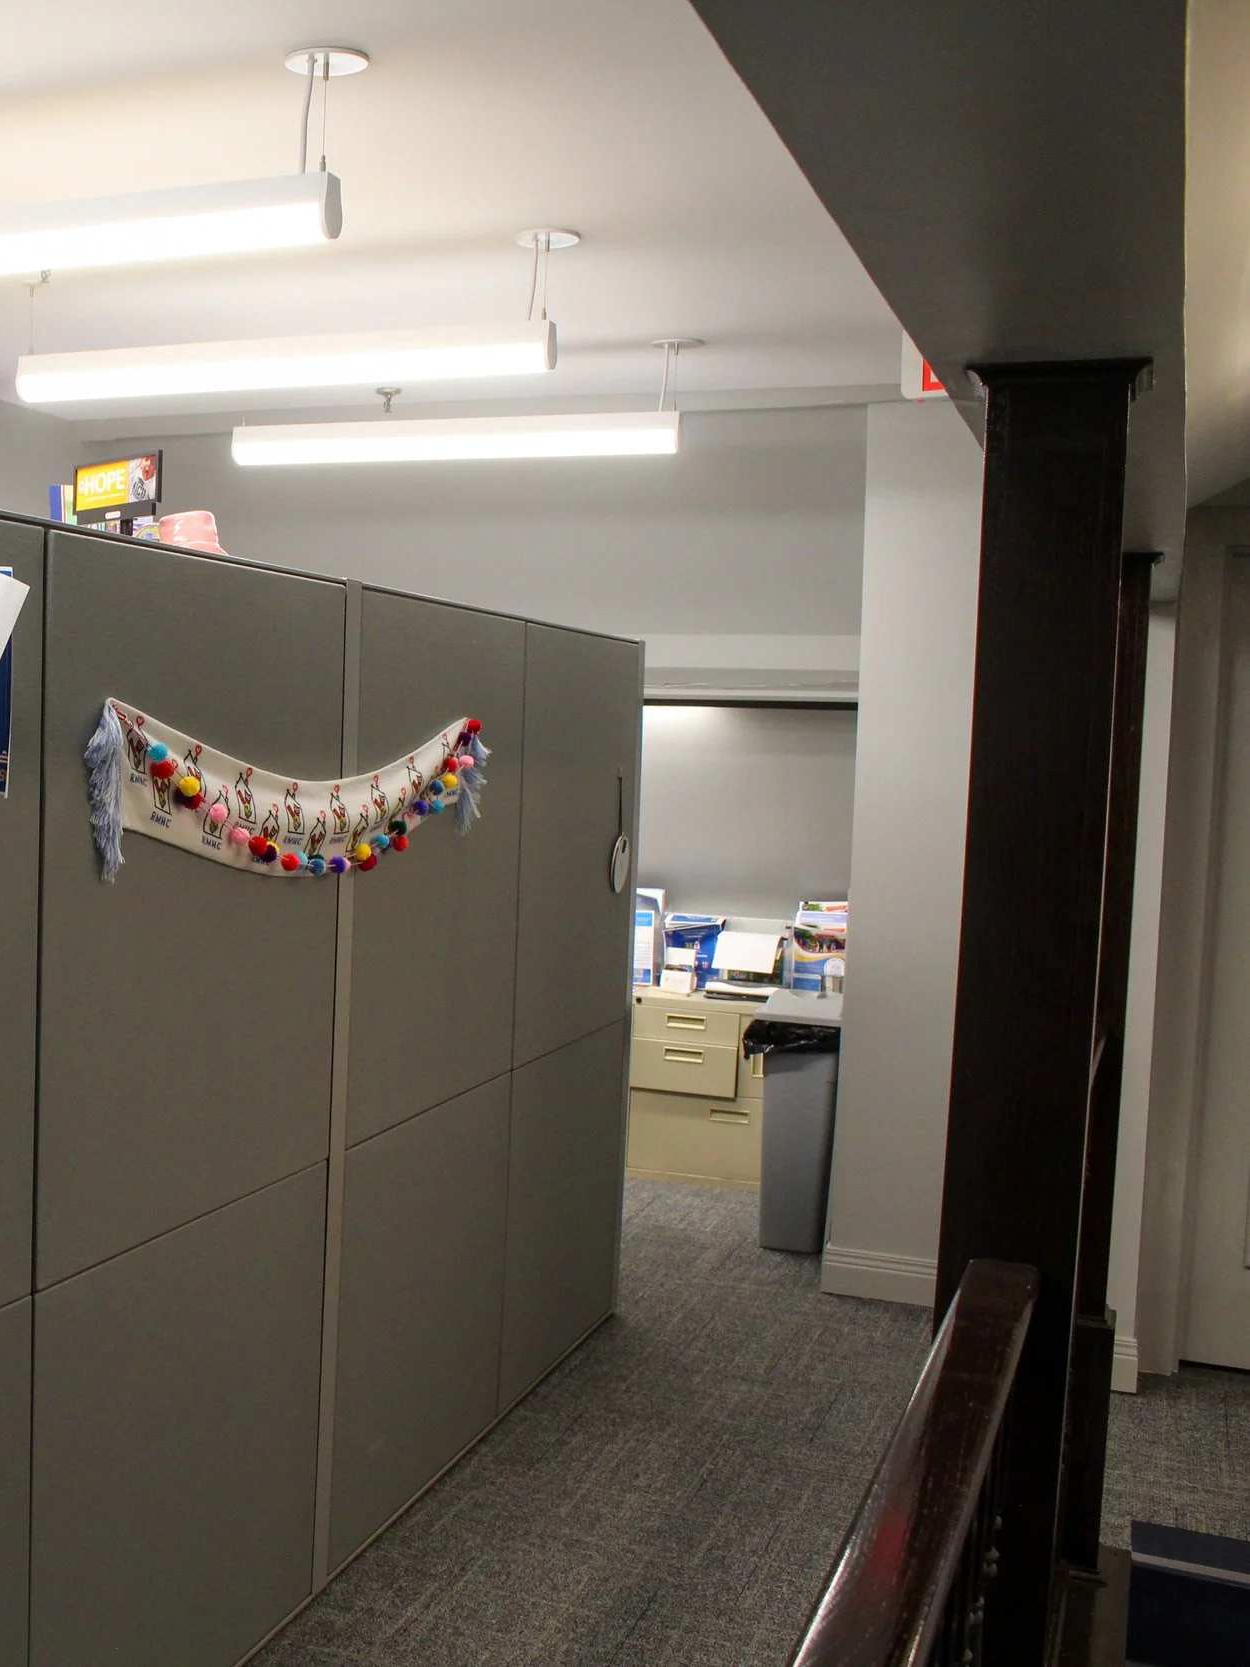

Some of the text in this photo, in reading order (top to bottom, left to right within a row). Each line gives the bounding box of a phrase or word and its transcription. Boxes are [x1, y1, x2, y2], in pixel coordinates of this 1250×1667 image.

[84, 469, 126, 495] HOPE
[149, 811, 172, 829] RMHC
[201, 836, 223, 850] RMHC
